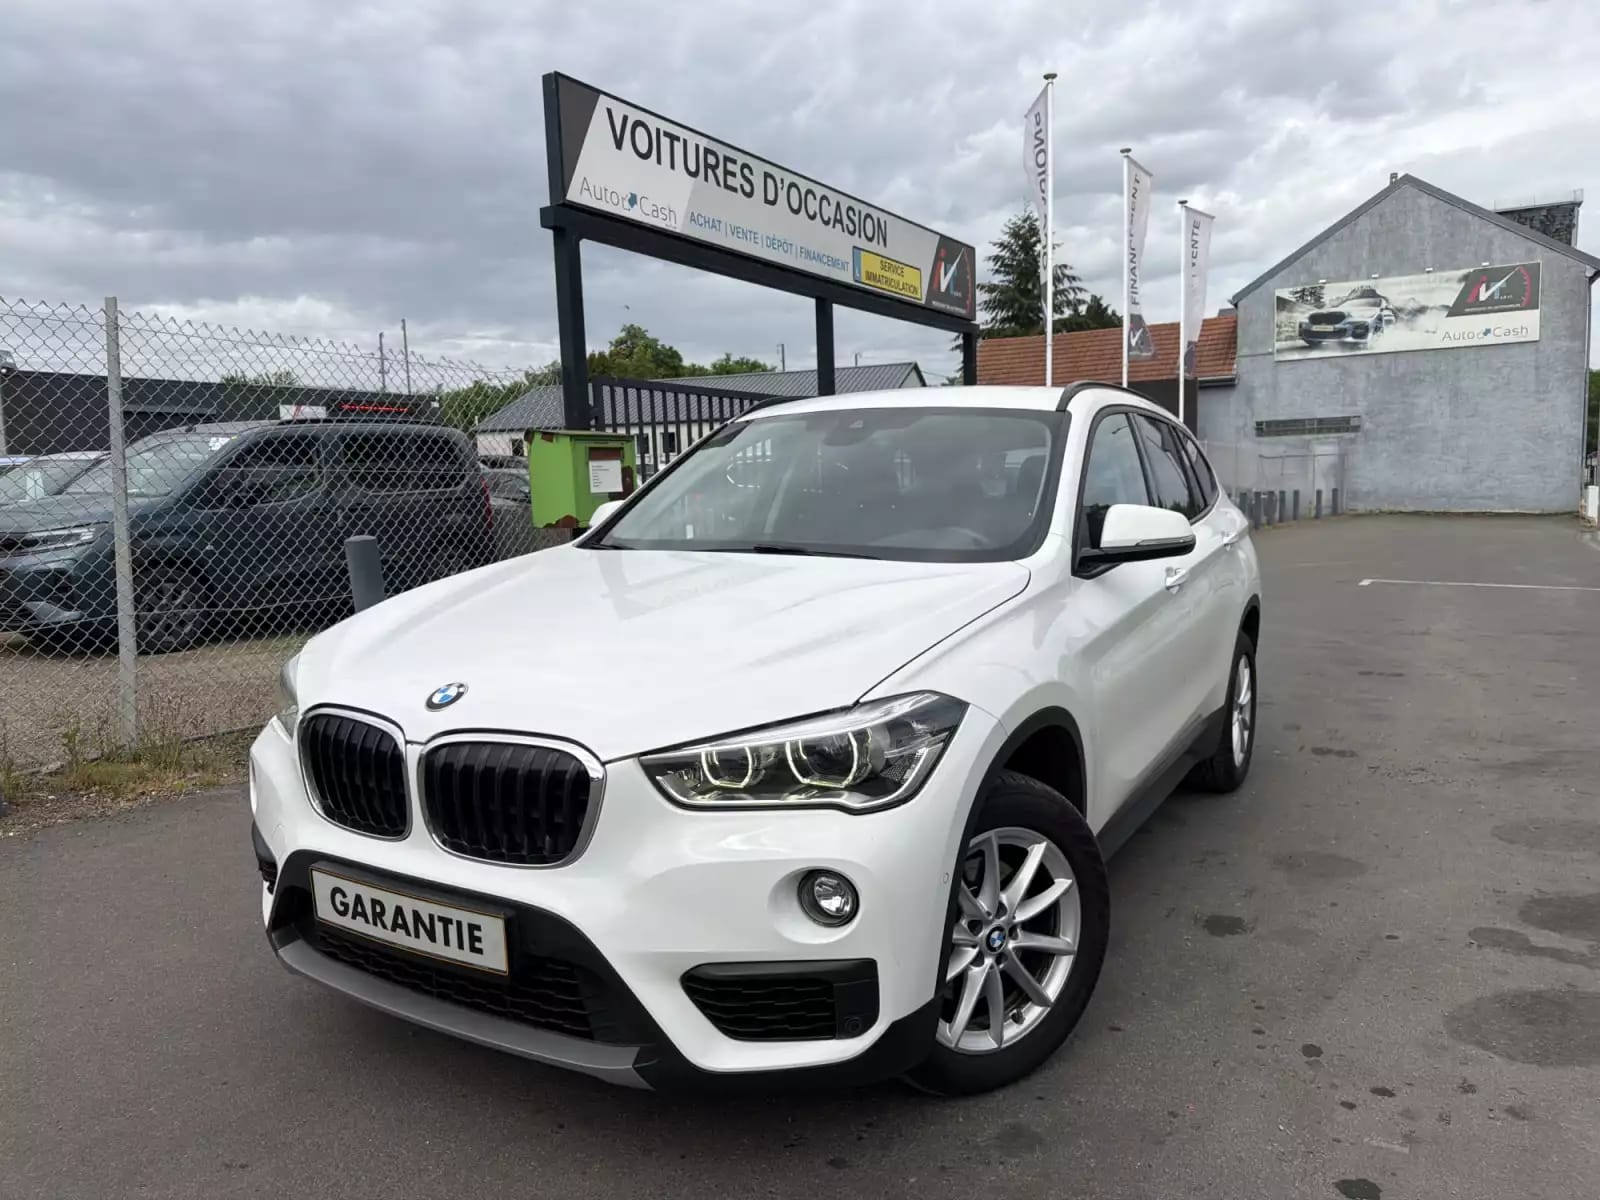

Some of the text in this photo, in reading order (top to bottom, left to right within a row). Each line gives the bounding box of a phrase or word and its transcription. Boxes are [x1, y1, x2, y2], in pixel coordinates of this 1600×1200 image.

[606, 107, 888, 249] VOITURES D'OCCASION
[639, 196, 677, 225] Cash
[689, 211, 850, 273] ACHAT VENTE DÉPÔT FINANCEMENT
[879, 259, 905, 278] SERVICE
[864, 270, 918, 297] IMMATRICULATION
[1492, 324, 1529, 338] Cash
[330, 886, 484, 956] GARANTIE
